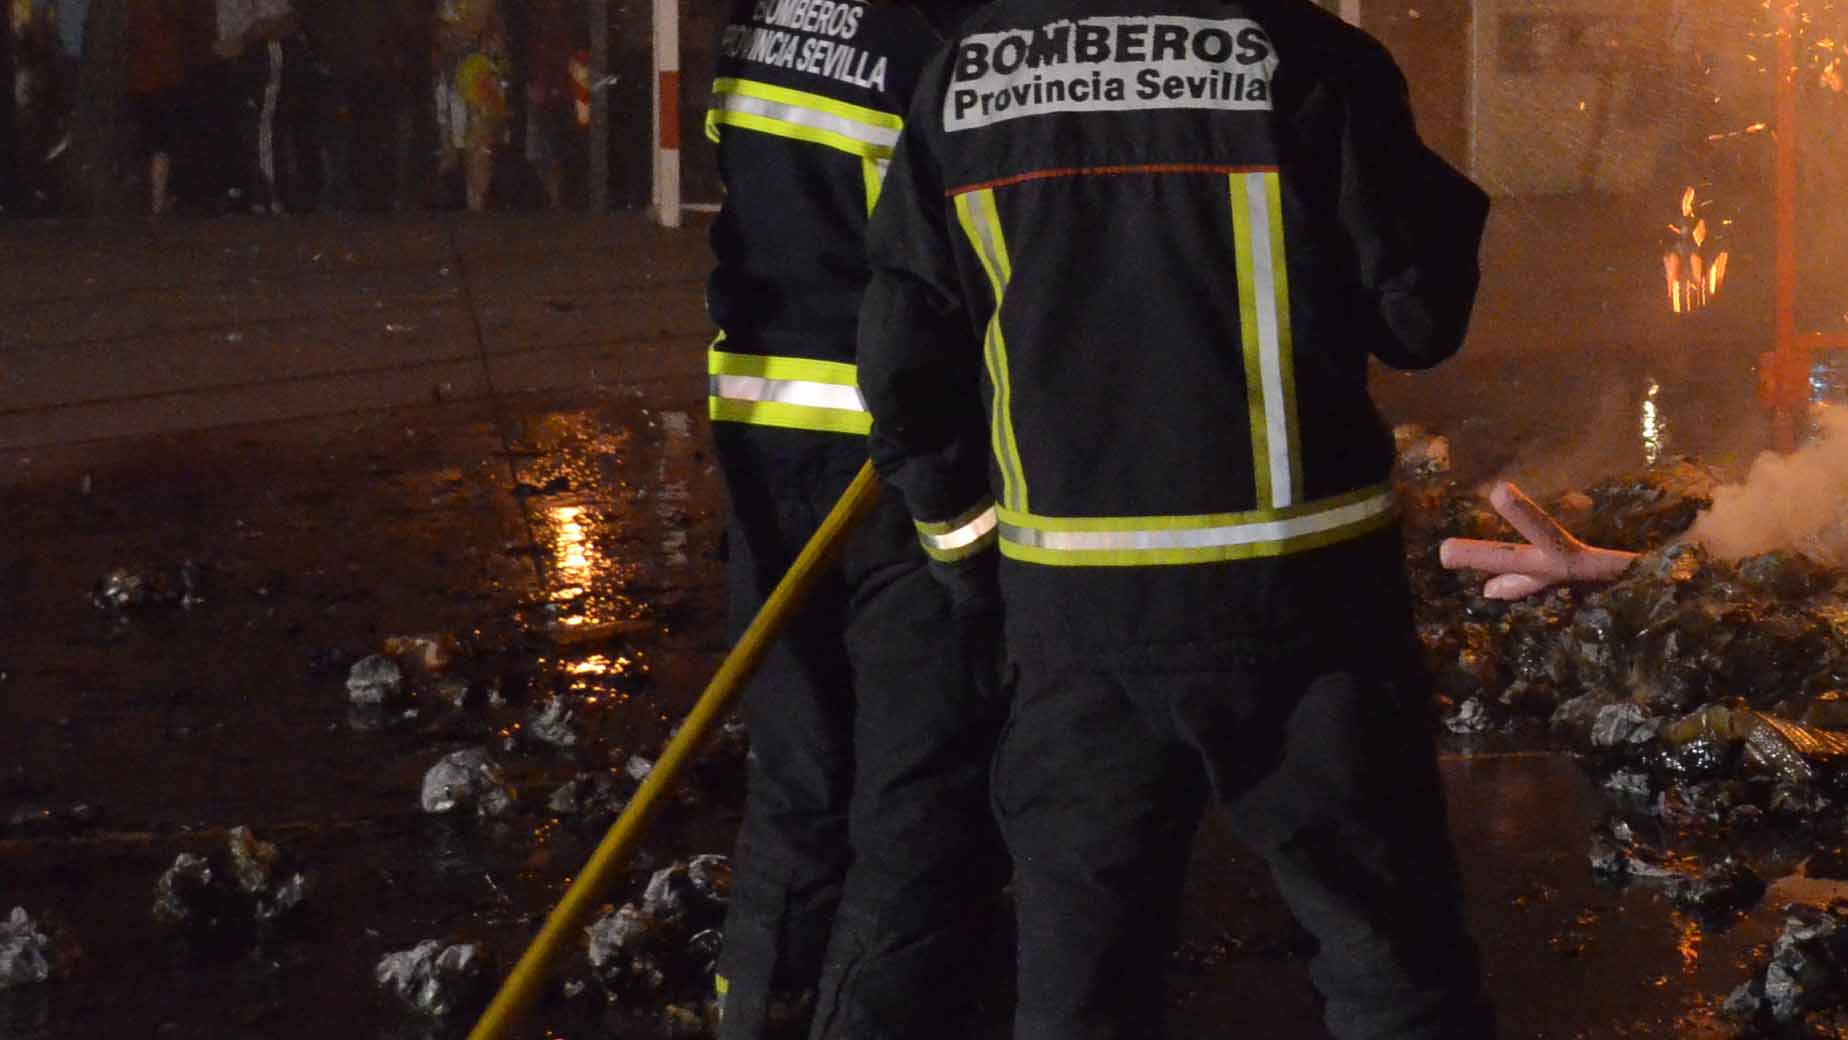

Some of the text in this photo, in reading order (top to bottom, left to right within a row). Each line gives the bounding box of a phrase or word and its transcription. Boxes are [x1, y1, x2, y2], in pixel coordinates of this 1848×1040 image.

[796, 37, 888, 93] SEVILLA
[955, 24, 1269, 83] BOMBEROS
[955, 68, 1267, 120] Provincia Sevilla
